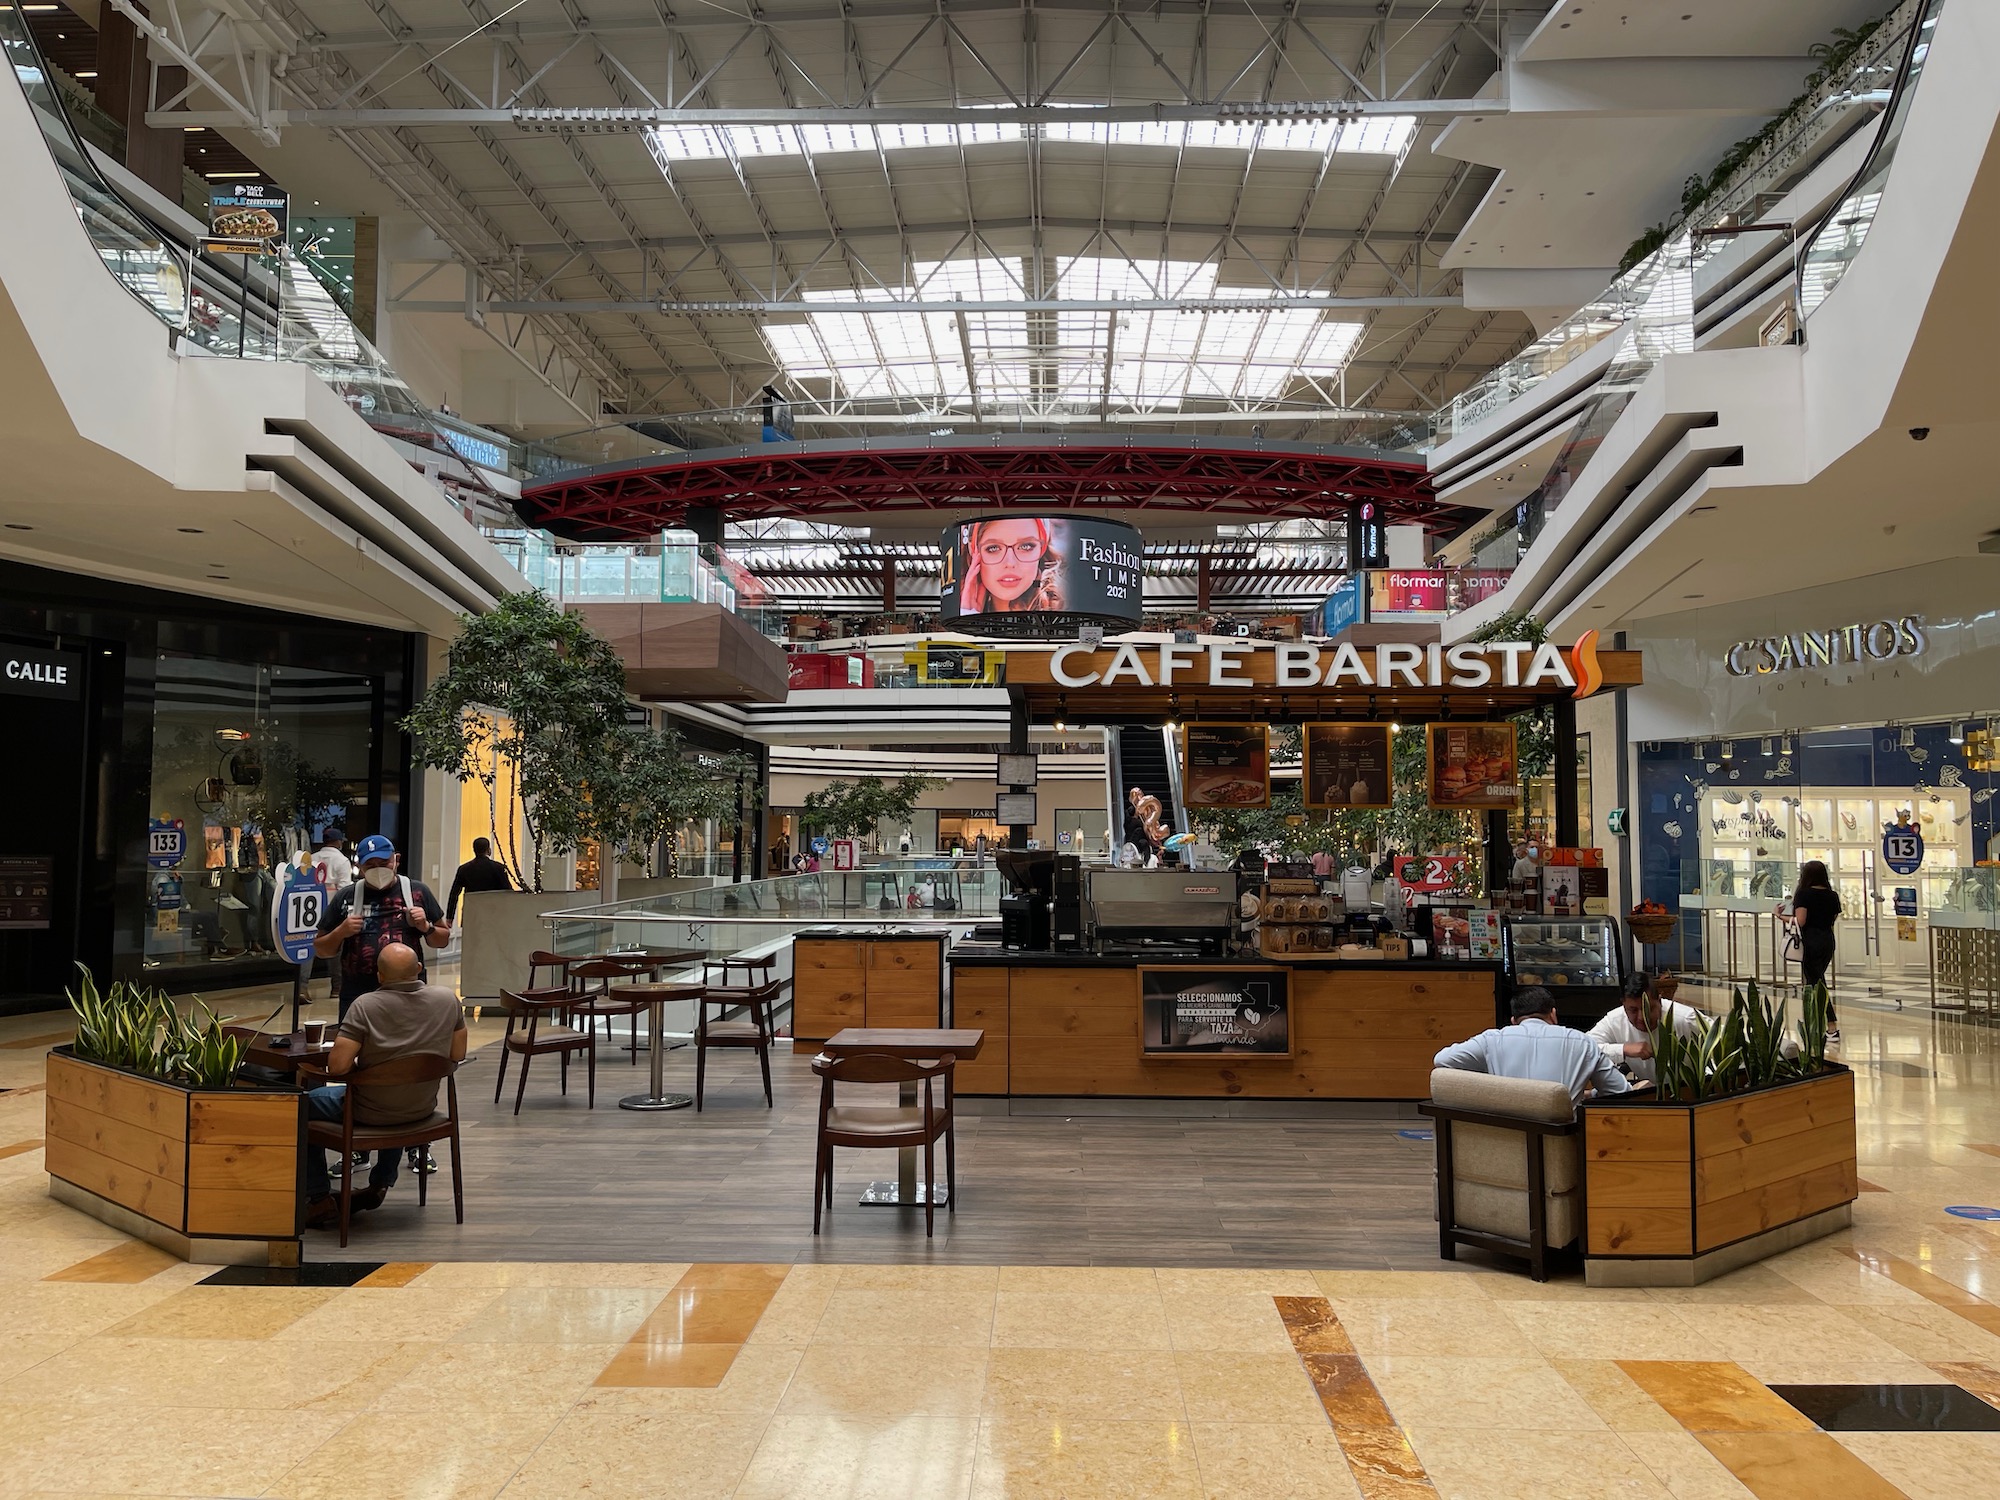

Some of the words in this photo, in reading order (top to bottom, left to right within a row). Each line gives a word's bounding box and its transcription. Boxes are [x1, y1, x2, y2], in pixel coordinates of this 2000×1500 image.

[213, 197, 246, 205] TRIPLE
[1368, 524, 1377, 558] flormar
[1080, 537, 1140, 571] Fashion
[1091, 566, 1137, 588] TIME
[1390, 574, 1444, 588] flormar
[1107, 585, 1127, 599] 2021
[5, 659, 67, 685] CALLE
[1049, 642, 1254, 688] CAFE
[1275, 641, 1577, 688] BARISTA
[1757, 667, 1900, 694] JOYERIA
[1738, 829, 1751, 838] en
[153, 834, 177, 851] 133
[1891, 839, 1915, 856] 13
[292, 895, 318, 929] 18
[1385, 943, 1400, 952] TIPS
[1176, 993, 1242, 1002] SELECCIONAMOS
[1210, 1023, 1234, 1034] TAZA
